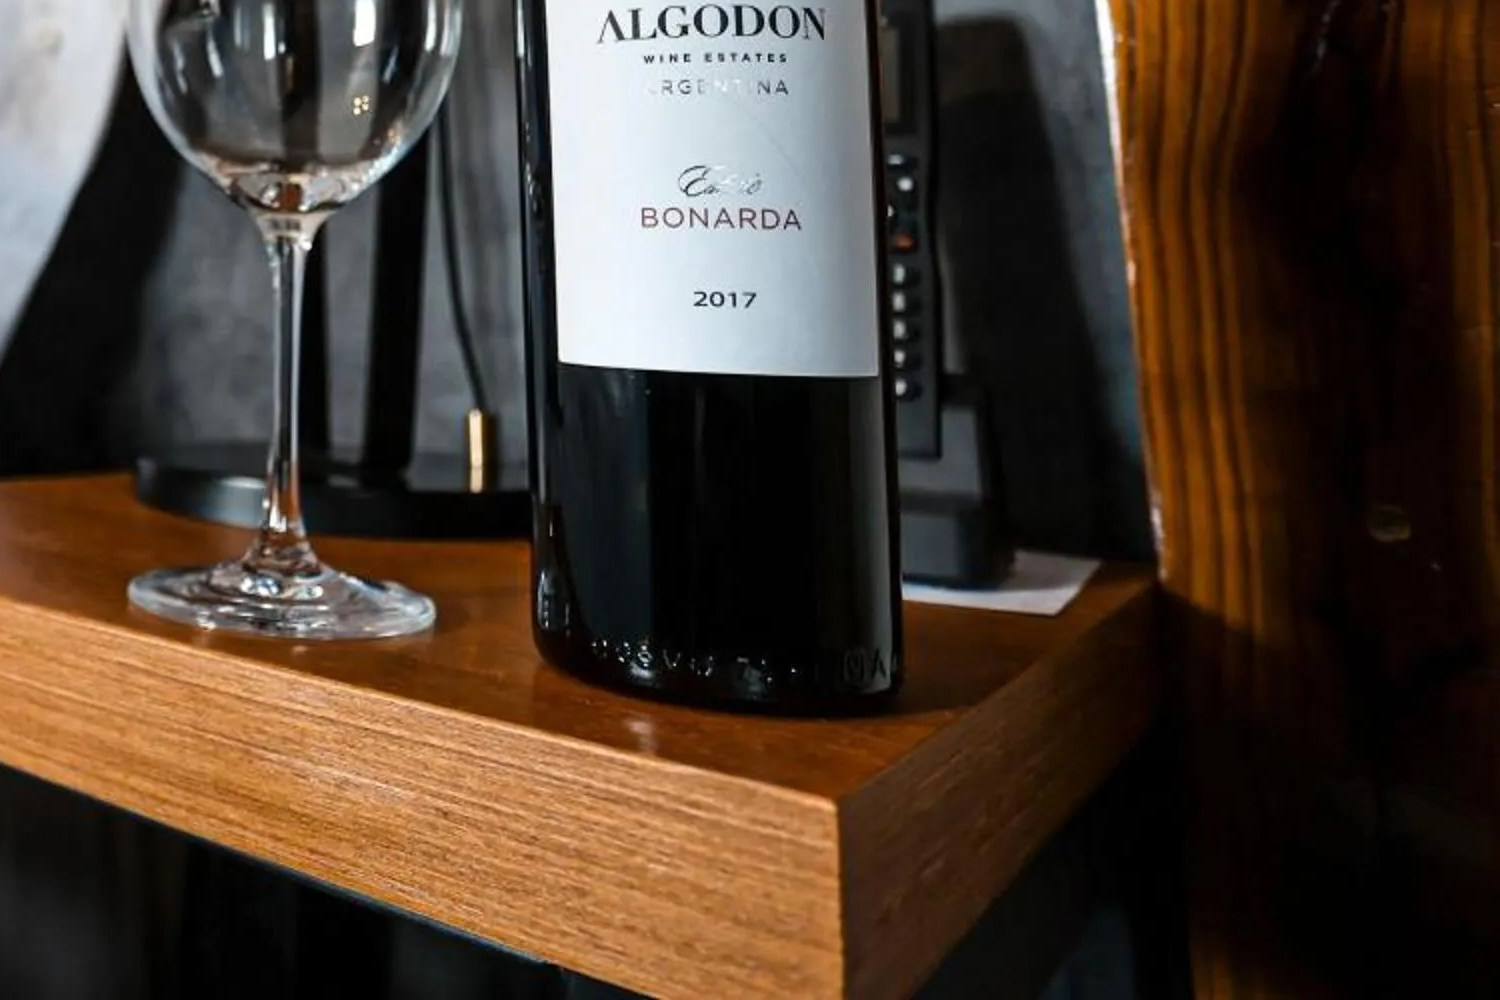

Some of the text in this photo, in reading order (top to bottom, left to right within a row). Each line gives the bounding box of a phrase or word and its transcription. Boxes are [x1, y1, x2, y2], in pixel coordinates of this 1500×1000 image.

[597, 4, 827, 45] ALGODON
[643, 52, 789, 65] WINE ESTATES
[641, 207, 802, 231] BONARDA
[693, 291, 757, 309] 2017
